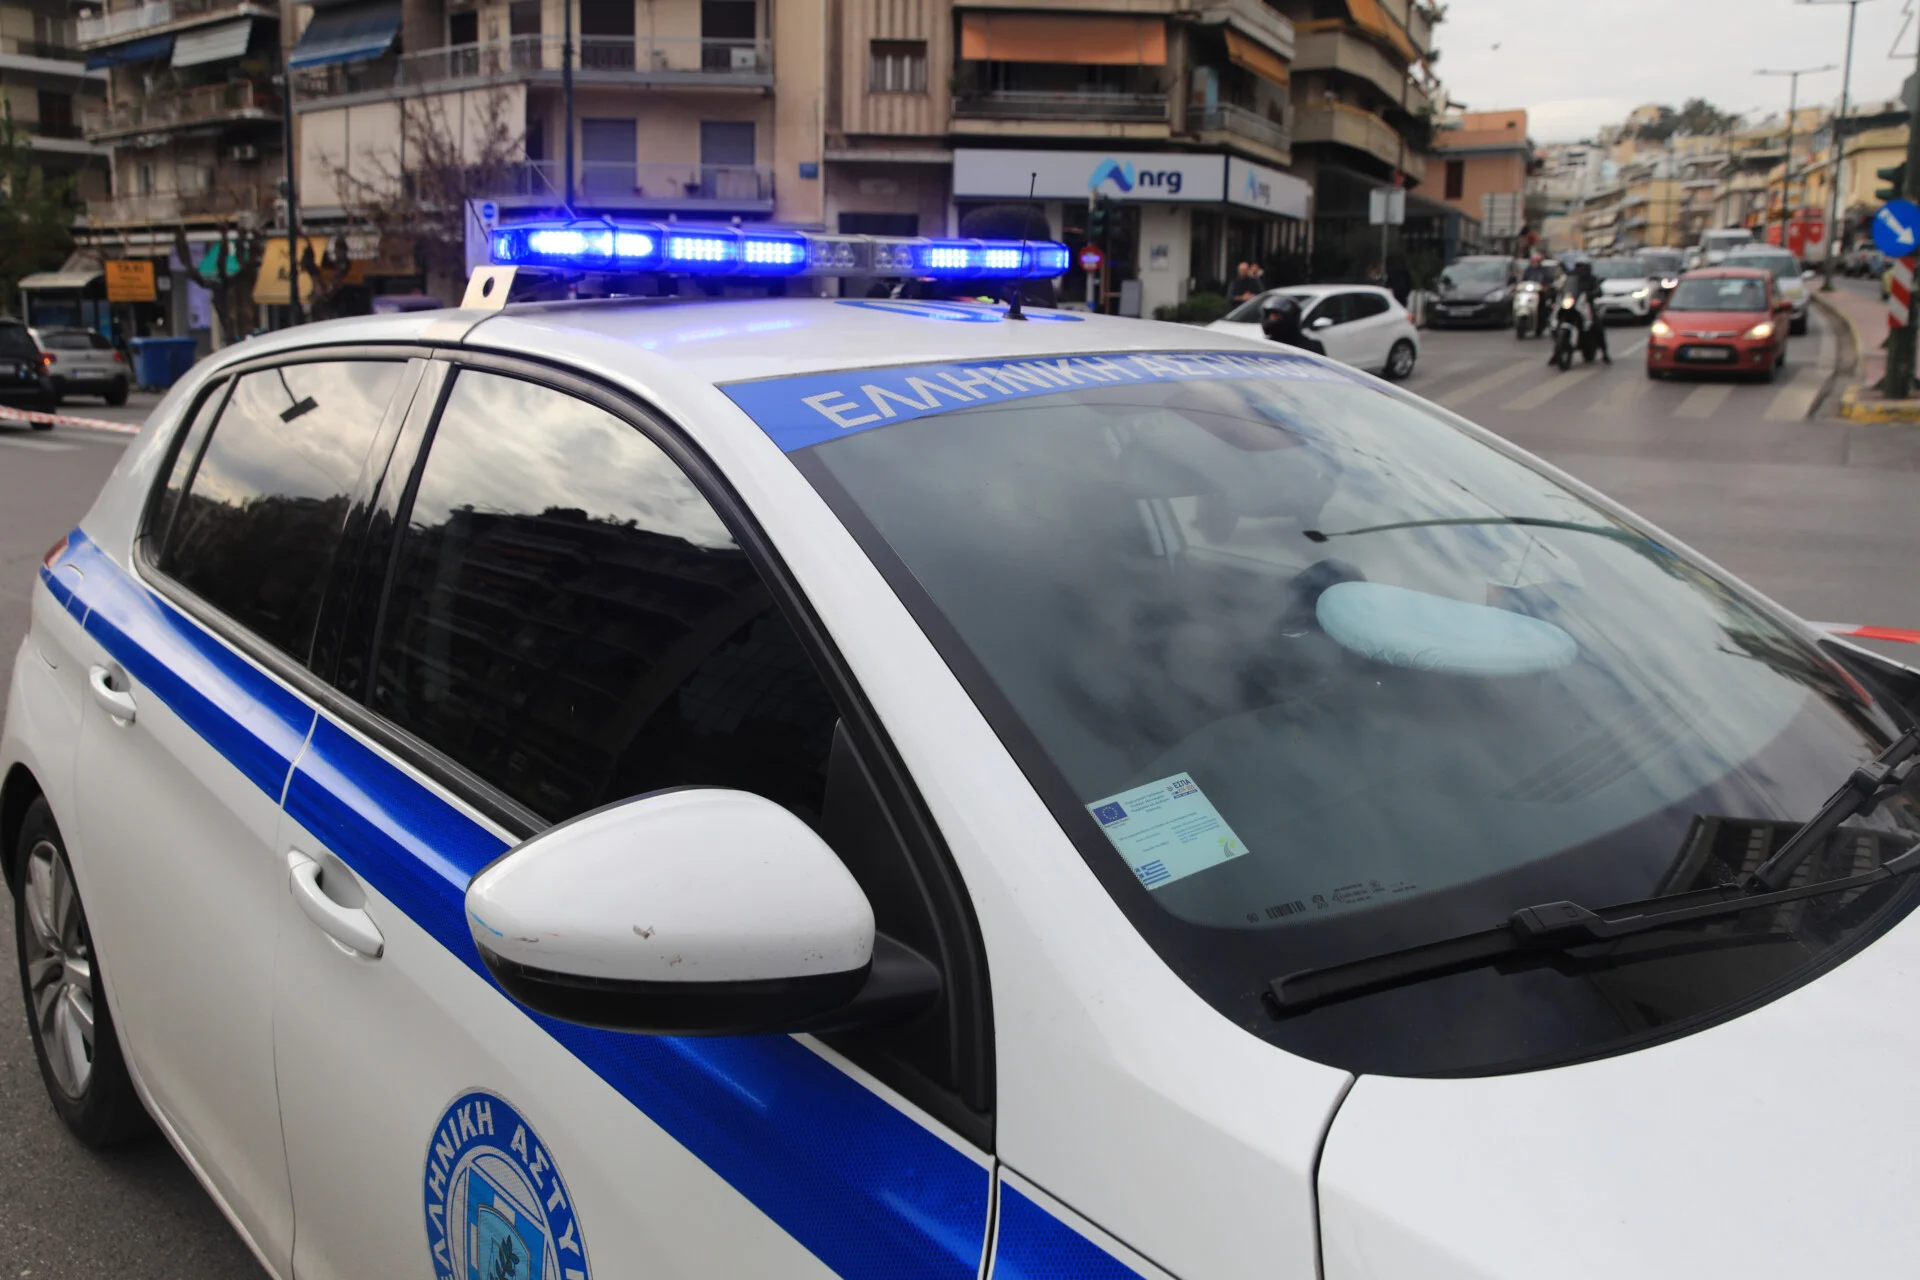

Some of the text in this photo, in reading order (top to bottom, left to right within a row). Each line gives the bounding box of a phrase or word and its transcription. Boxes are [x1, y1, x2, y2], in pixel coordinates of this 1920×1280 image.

[1139, 170, 1182, 194] nrg
[801, 356, 1142, 428] ΕΛΛΗΝΙΚΗ
[1172, 778, 1192, 789] ΕΣΠΑ
